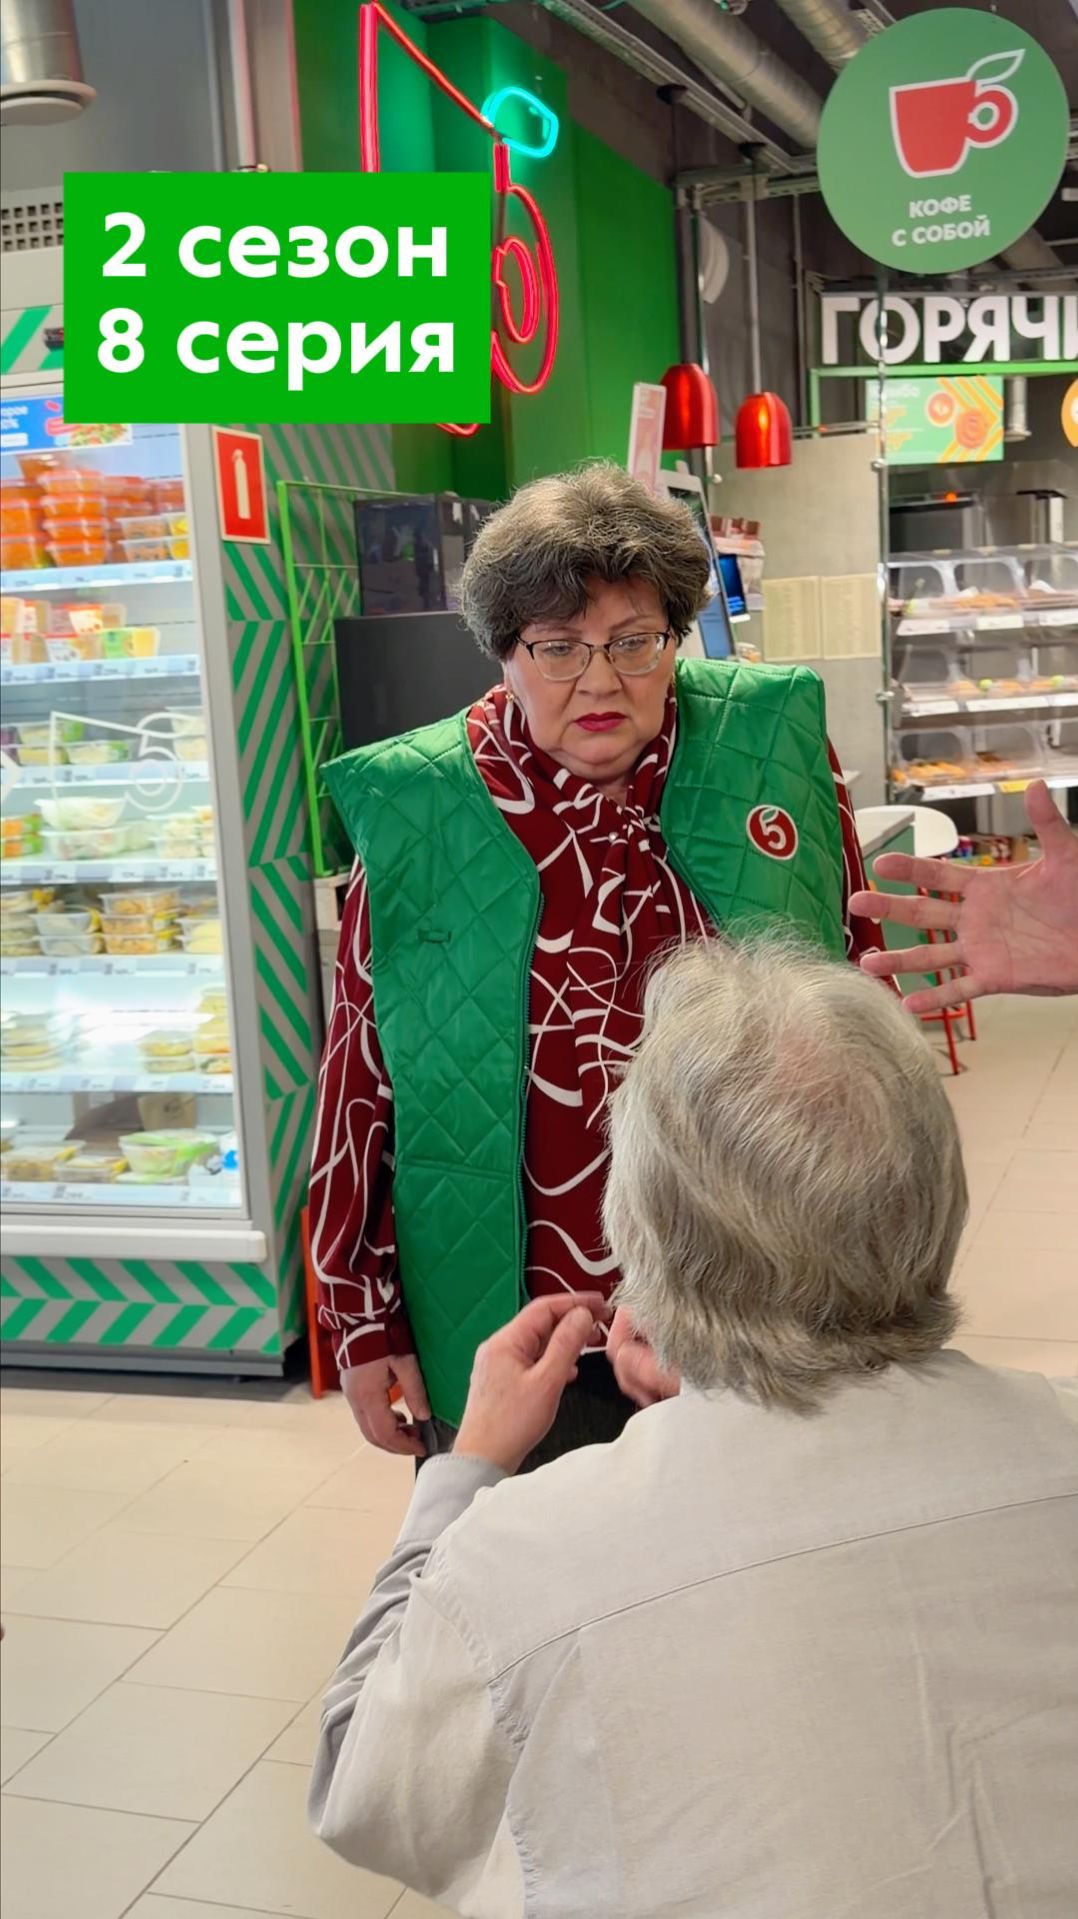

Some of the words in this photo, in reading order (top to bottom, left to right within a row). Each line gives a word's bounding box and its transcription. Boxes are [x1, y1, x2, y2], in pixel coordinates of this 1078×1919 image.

[909, 194, 972, 218] КОФЕ
[891, 229, 907, 247] С
[912, 214, 990, 245] СОБОЙ
